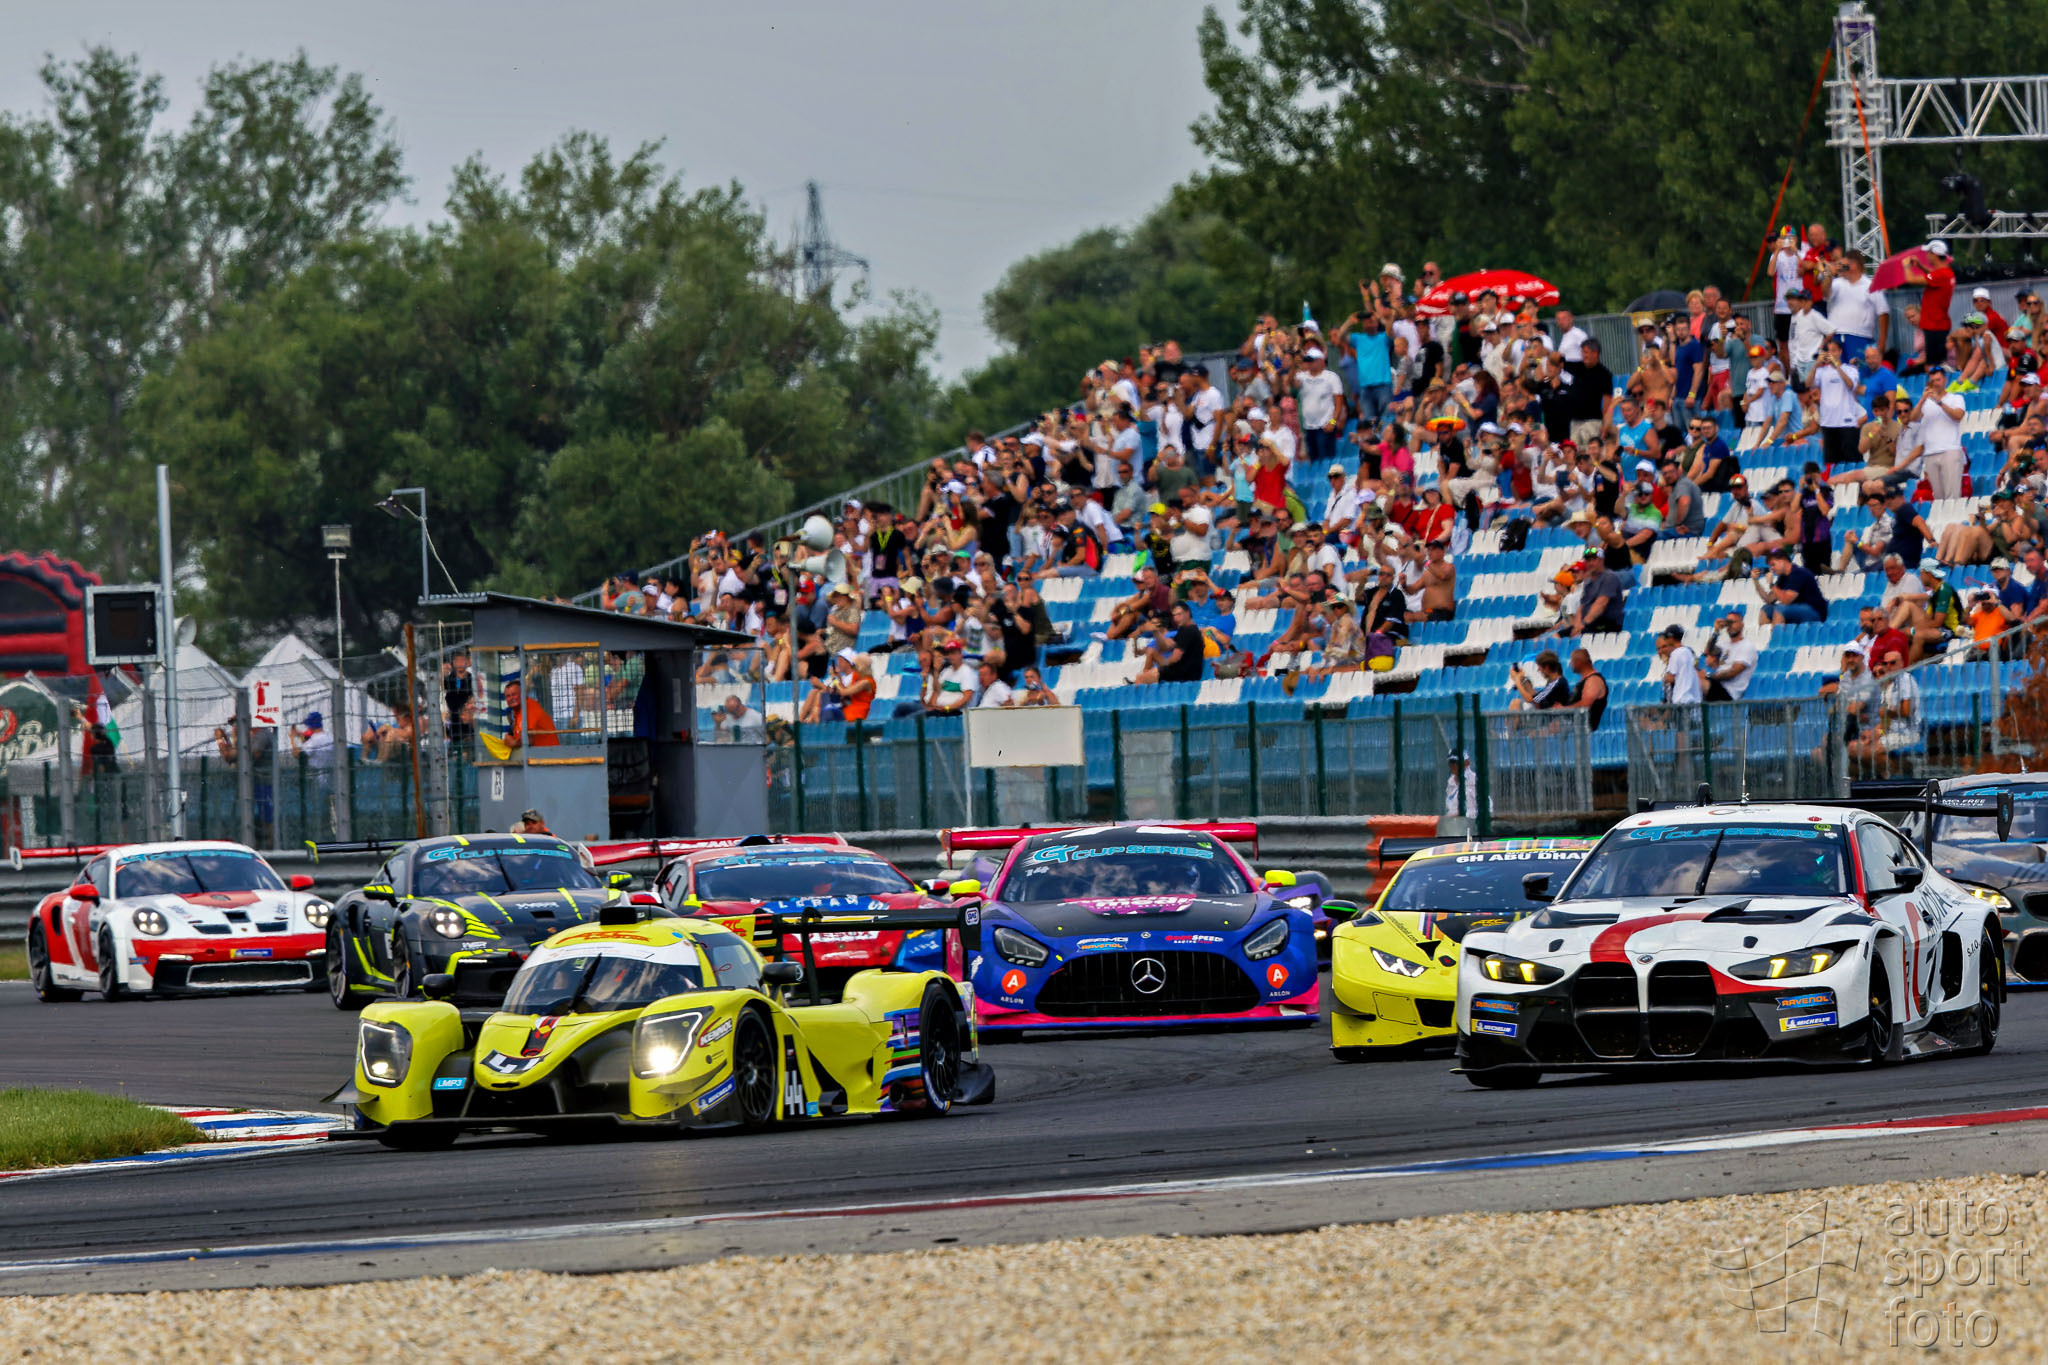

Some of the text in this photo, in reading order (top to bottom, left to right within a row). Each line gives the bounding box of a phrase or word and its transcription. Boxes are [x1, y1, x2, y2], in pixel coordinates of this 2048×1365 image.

[1032, 844, 1079, 863] GT
[1125, 845, 1214, 859] SERIES
[1456, 854, 1484, 863] 6H
[1488, 852, 1531, 861] ABU
[1781, 995, 1829, 1007] RAVENOL
[1796, 1016, 1831, 1026] MICHELIN
[437, 1078, 462, 1087] LMP3
[784, 1070, 804, 1115] 44
